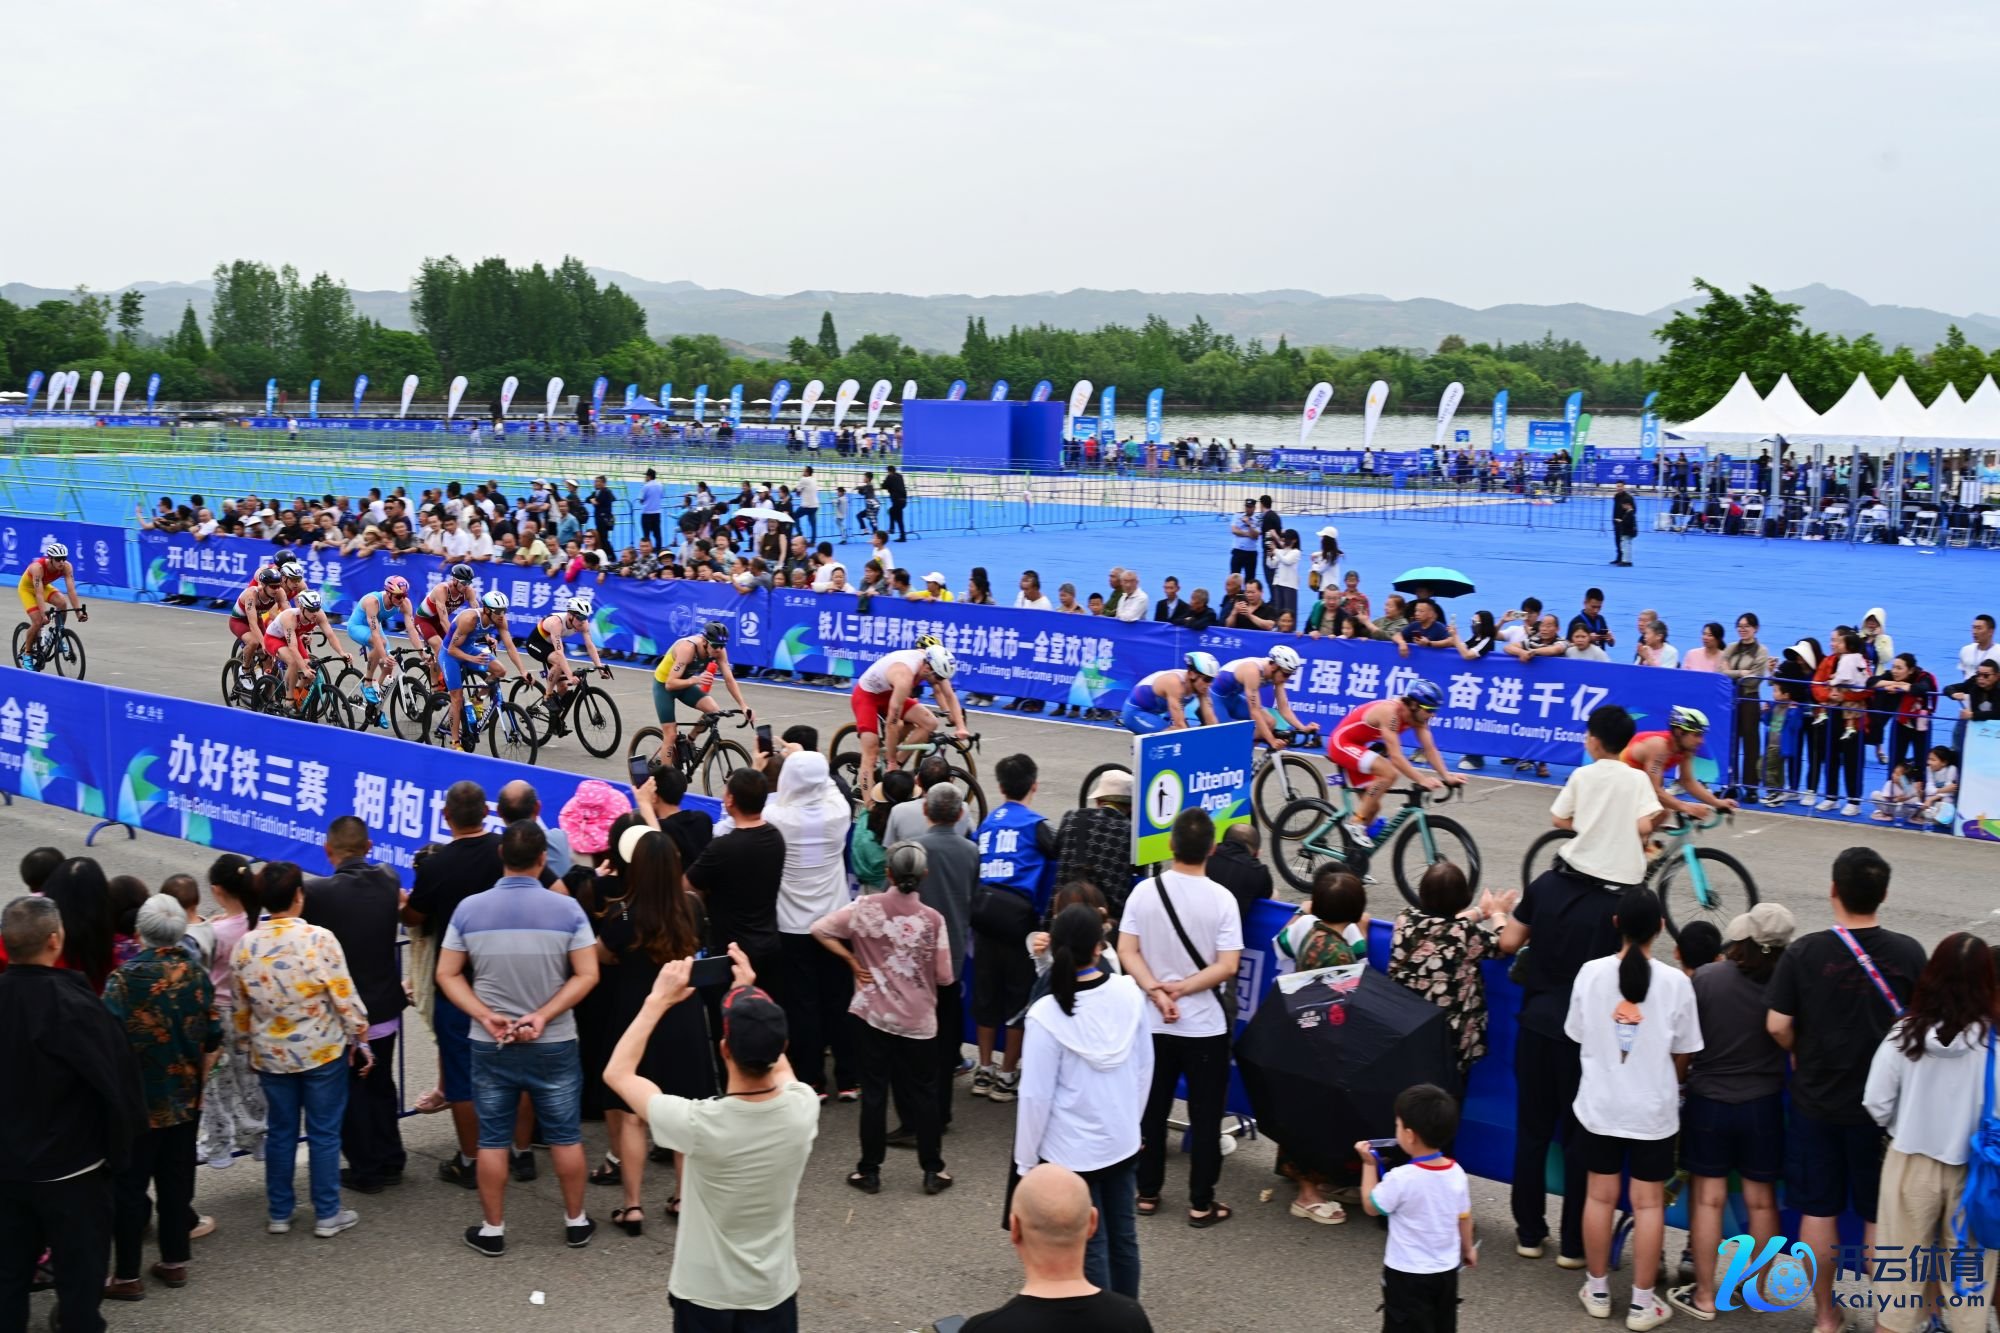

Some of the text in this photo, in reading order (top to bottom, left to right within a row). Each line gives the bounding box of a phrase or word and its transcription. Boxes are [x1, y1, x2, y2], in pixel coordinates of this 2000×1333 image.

[167, 546, 248, 576] 开山出大江
[823, 645, 858, 661] Triathlon
[978, 662, 1011, 680] Jintang
[1012, 666, 1052, 682] Welcome
[1447, 672, 1609, 722] 奋进千亿
[0, 696, 49, 750] 金堂
[1444, 718, 1451, 728] a
[1453, 715, 1474, 731] 100
[1474, 717, 1509, 735] billion
[1511, 722, 1552, 743] County
[1553, 727, 1586, 744] Econo
[167, 733, 330, 816] 办好铁三赛
[1189, 766, 1245, 794] Littering
[1200, 792, 1232, 812] Area
[251, 810, 288, 837] Triathlon
[288, 820, 315, 844] Event
[315, 831, 327, 847] an
[979, 858, 1015, 879] edia
